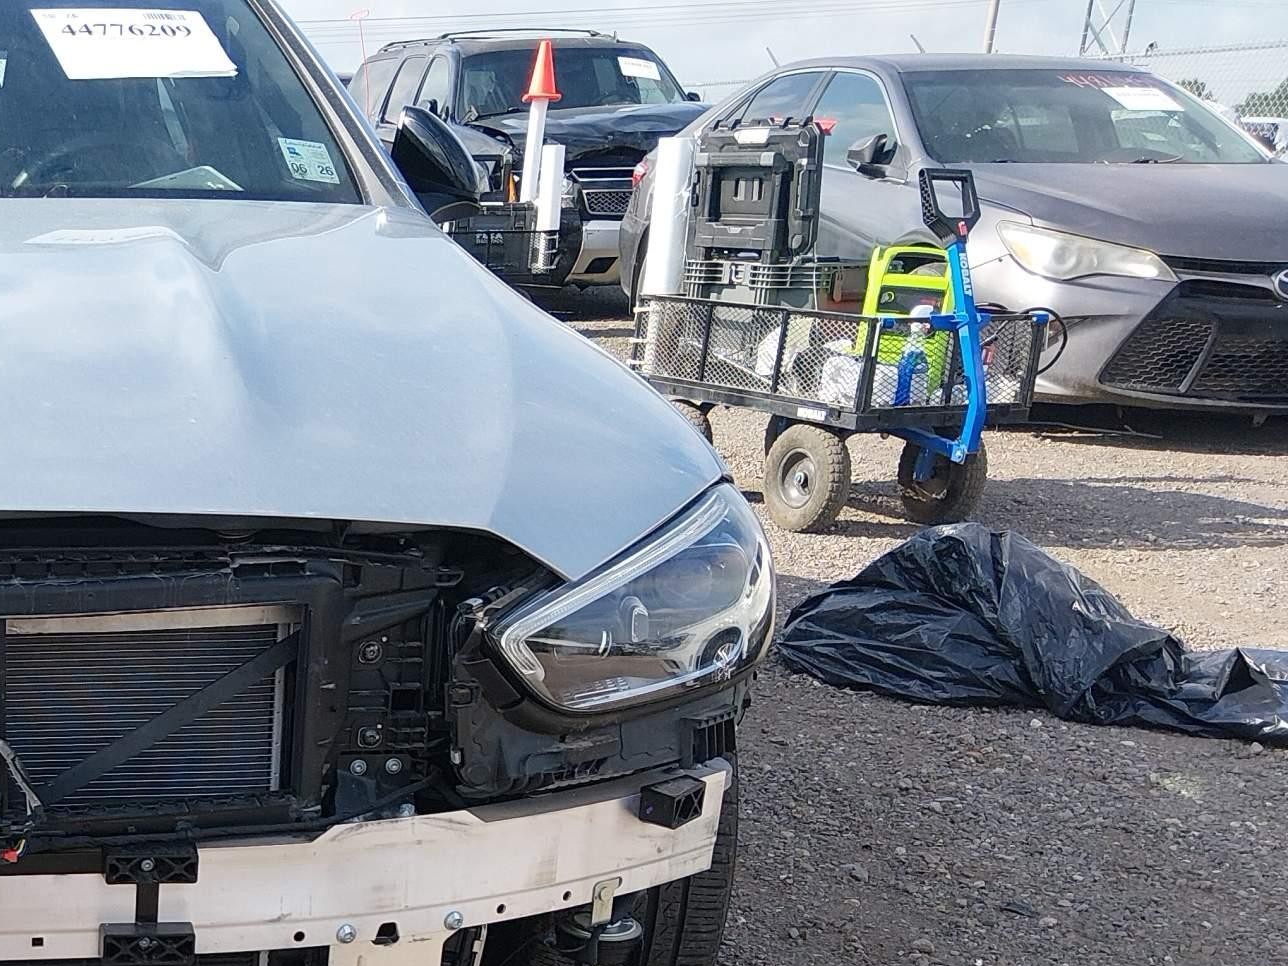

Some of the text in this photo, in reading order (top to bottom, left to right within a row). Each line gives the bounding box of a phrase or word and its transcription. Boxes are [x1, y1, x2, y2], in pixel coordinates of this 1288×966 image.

[61, 22, 192, 38] 44776209
[290, 162, 334, 177] 06 26
[958, 252, 973, 297] KOBALT
